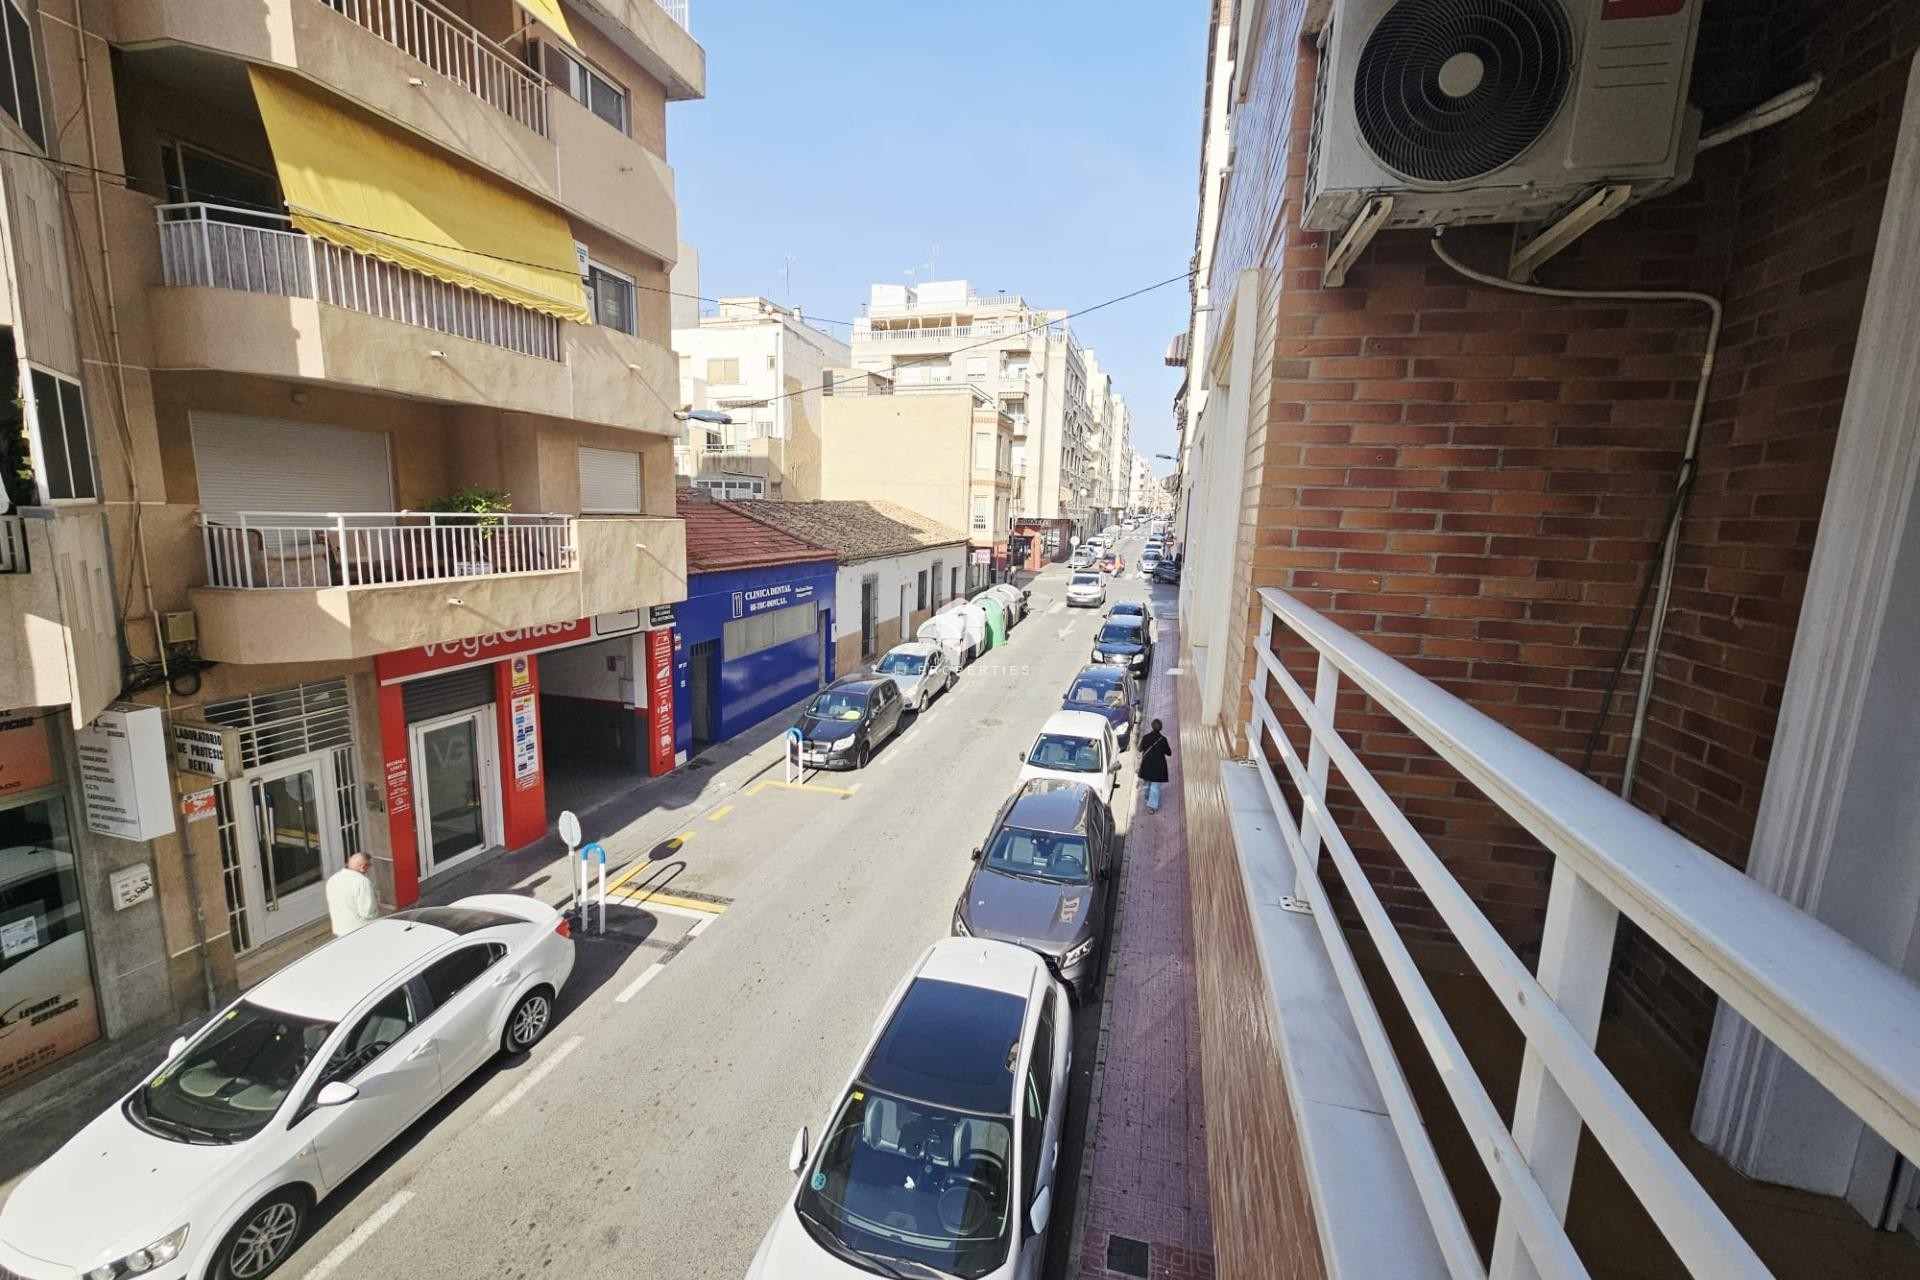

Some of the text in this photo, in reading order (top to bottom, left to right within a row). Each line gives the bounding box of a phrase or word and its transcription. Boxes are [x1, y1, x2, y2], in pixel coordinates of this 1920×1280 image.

[744, 588, 770, 601] CLINICA
[770, 584, 792, 595] DENTAL
[175, 727, 222, 746] LABORATORIO
[177, 742, 224, 761] DE PROTESIS
[188, 758, 215, 774] DENTAL
[19, 994, 61, 1019] LEVANTE
[31, 999, 79, 1026] SERVICIOS
